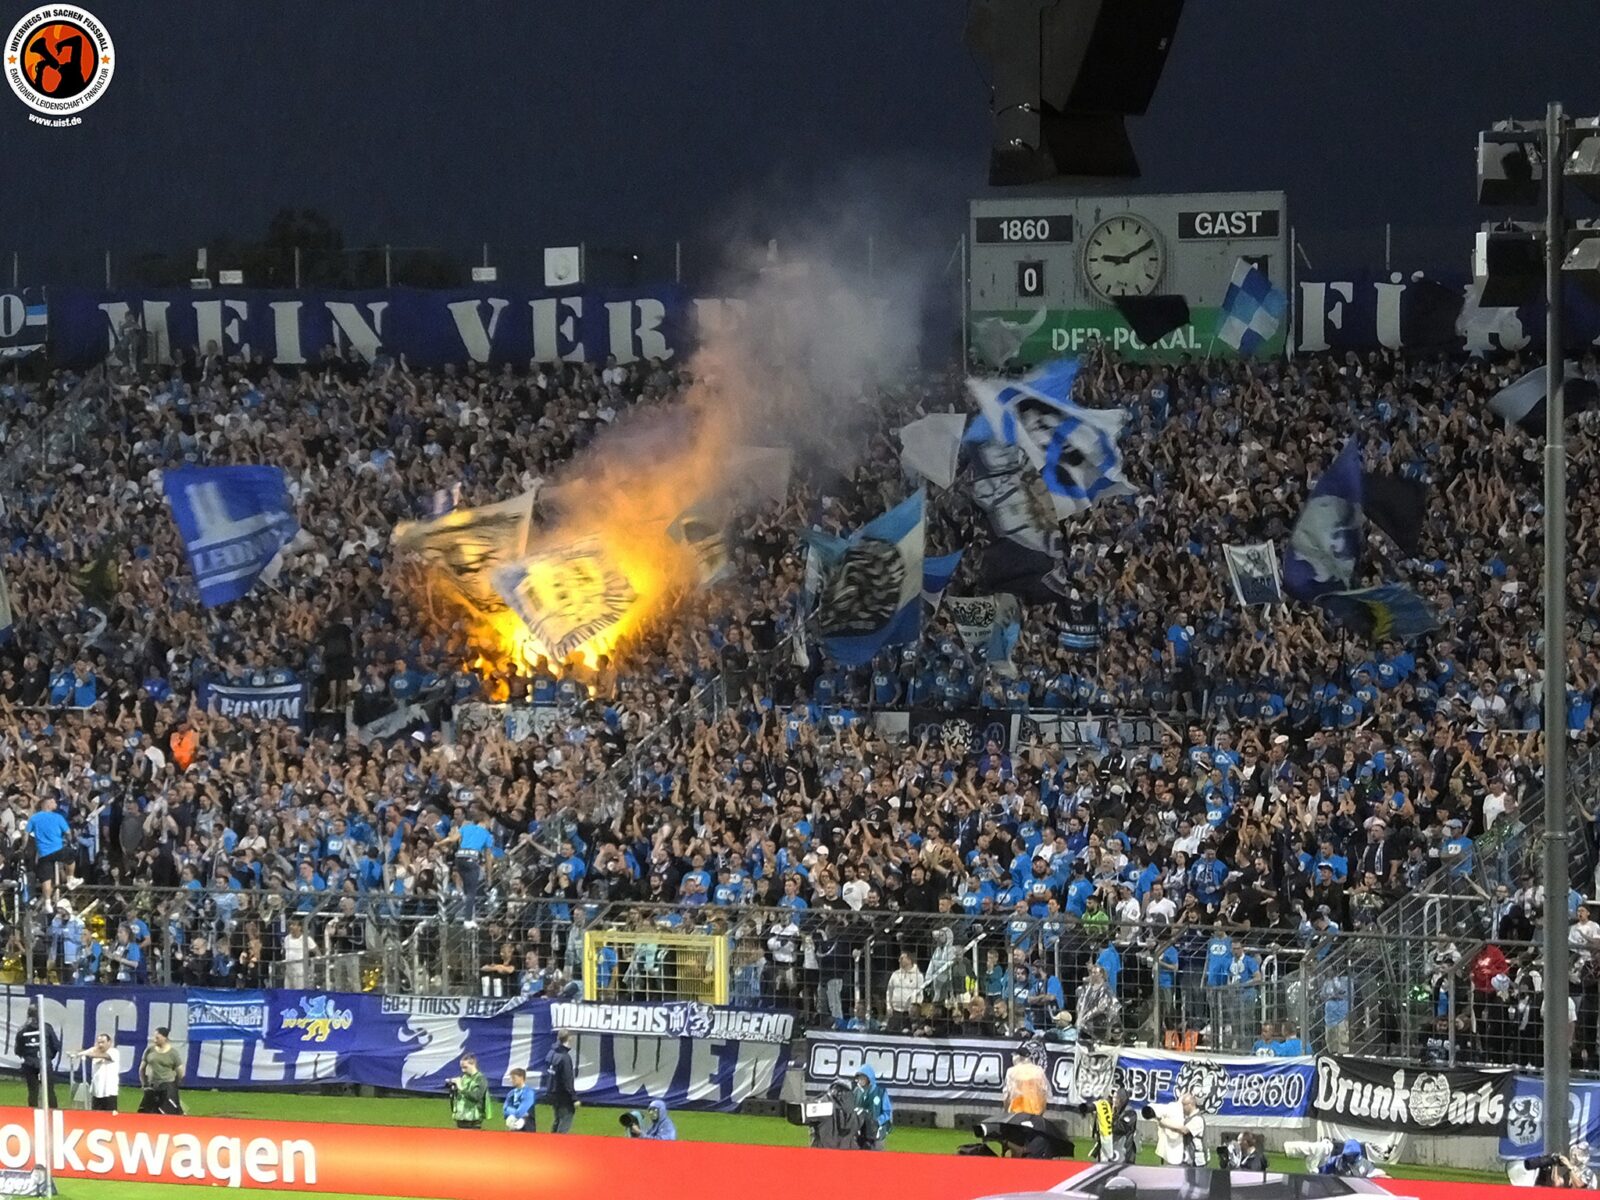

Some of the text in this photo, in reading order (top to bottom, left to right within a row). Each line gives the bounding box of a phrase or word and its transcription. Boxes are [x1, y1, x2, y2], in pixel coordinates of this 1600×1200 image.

[999, 219, 1050, 240] 1860
[1194, 211, 1262, 235] GAST
[1023, 268, 1037, 292] 0
[98, 299, 389, 365] MEIN
[418, 997, 460, 1015] MUSS
[711, 1010, 794, 1040] JUGEND
[811, 1044, 1004, 1087] COMITIVA
[1231, 1072, 1305, 1108] 1860
[1314, 1056, 1412, 1124] Drunk
[0, 1109, 317, 1188] olkswagen
